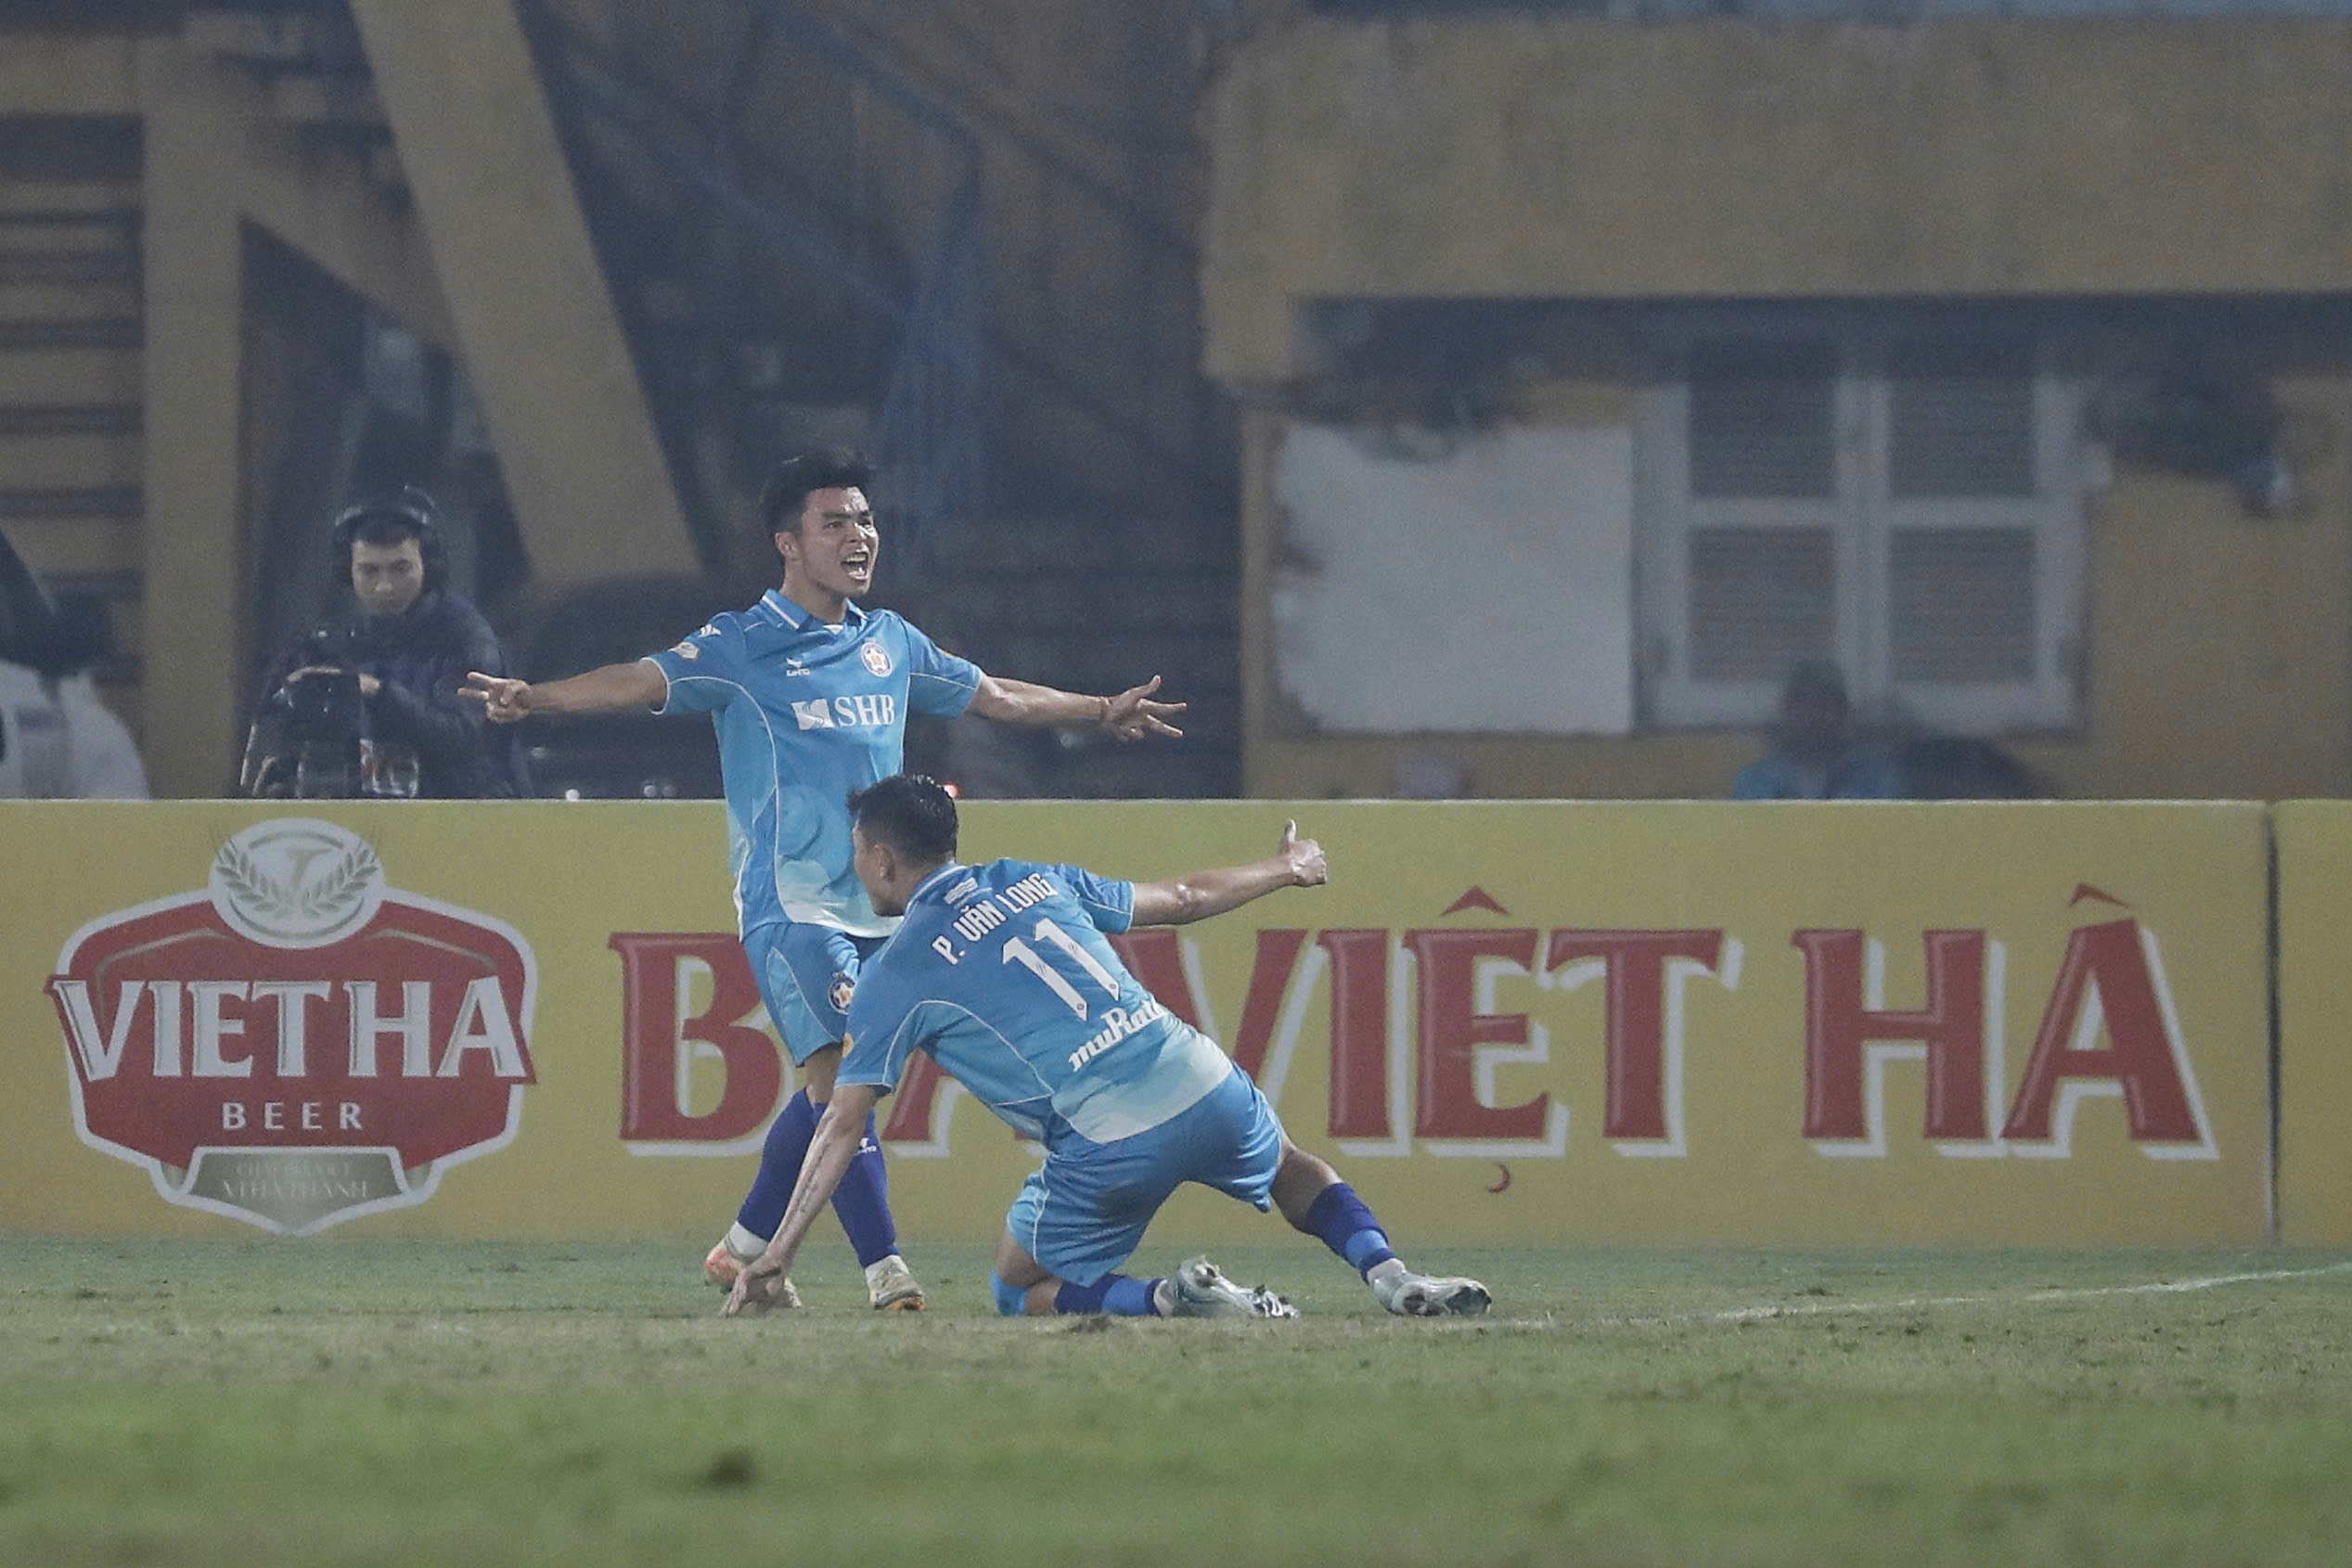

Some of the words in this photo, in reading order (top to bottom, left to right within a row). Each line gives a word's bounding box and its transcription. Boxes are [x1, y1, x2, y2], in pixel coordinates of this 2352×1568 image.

[834, 694, 895, 727] SHB
[932, 934, 966, 966] P.
[995, 872, 1059, 914] LONG
[1002, 917, 1119, 1022] 11
[222, 1101, 364, 1130] BEER
